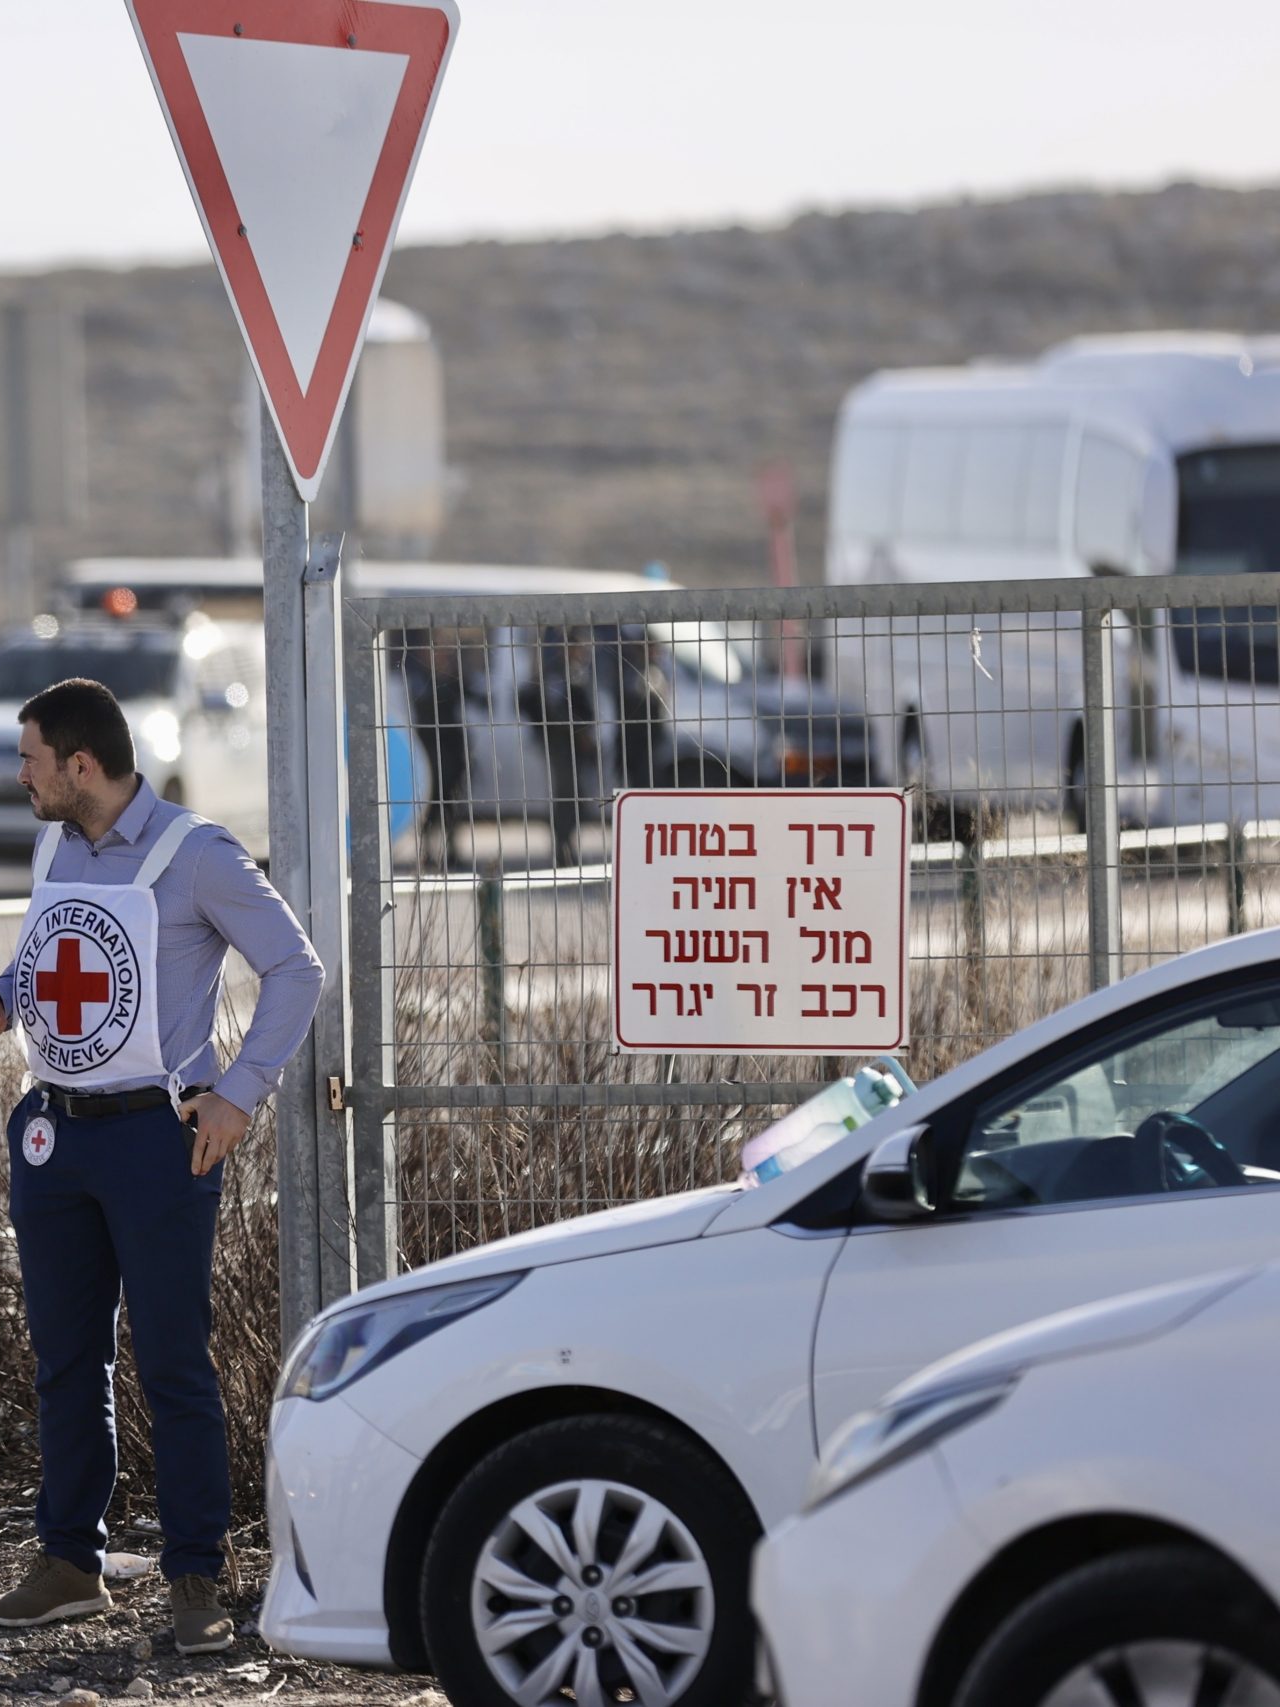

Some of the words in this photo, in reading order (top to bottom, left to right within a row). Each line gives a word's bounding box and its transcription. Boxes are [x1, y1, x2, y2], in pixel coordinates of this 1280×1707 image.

[645, 823, 757, 864] בטחון
[787, 823, 874, 865] דרך
[673, 876, 756, 910] חניה
[787, 876, 842, 917] אין
[645, 930, 769, 963] השער
[799, 927, 872, 965] מול
[20, 931, 42, 1027] COMITE
[46, 907, 133, 1029] INTERNATIONAL
[632, 982, 714, 1017] יגרר
[736, 984, 776, 1016] זר
[801, 984, 886, 1018] רכב
[39, 1034, 109, 1067] GENEVE
